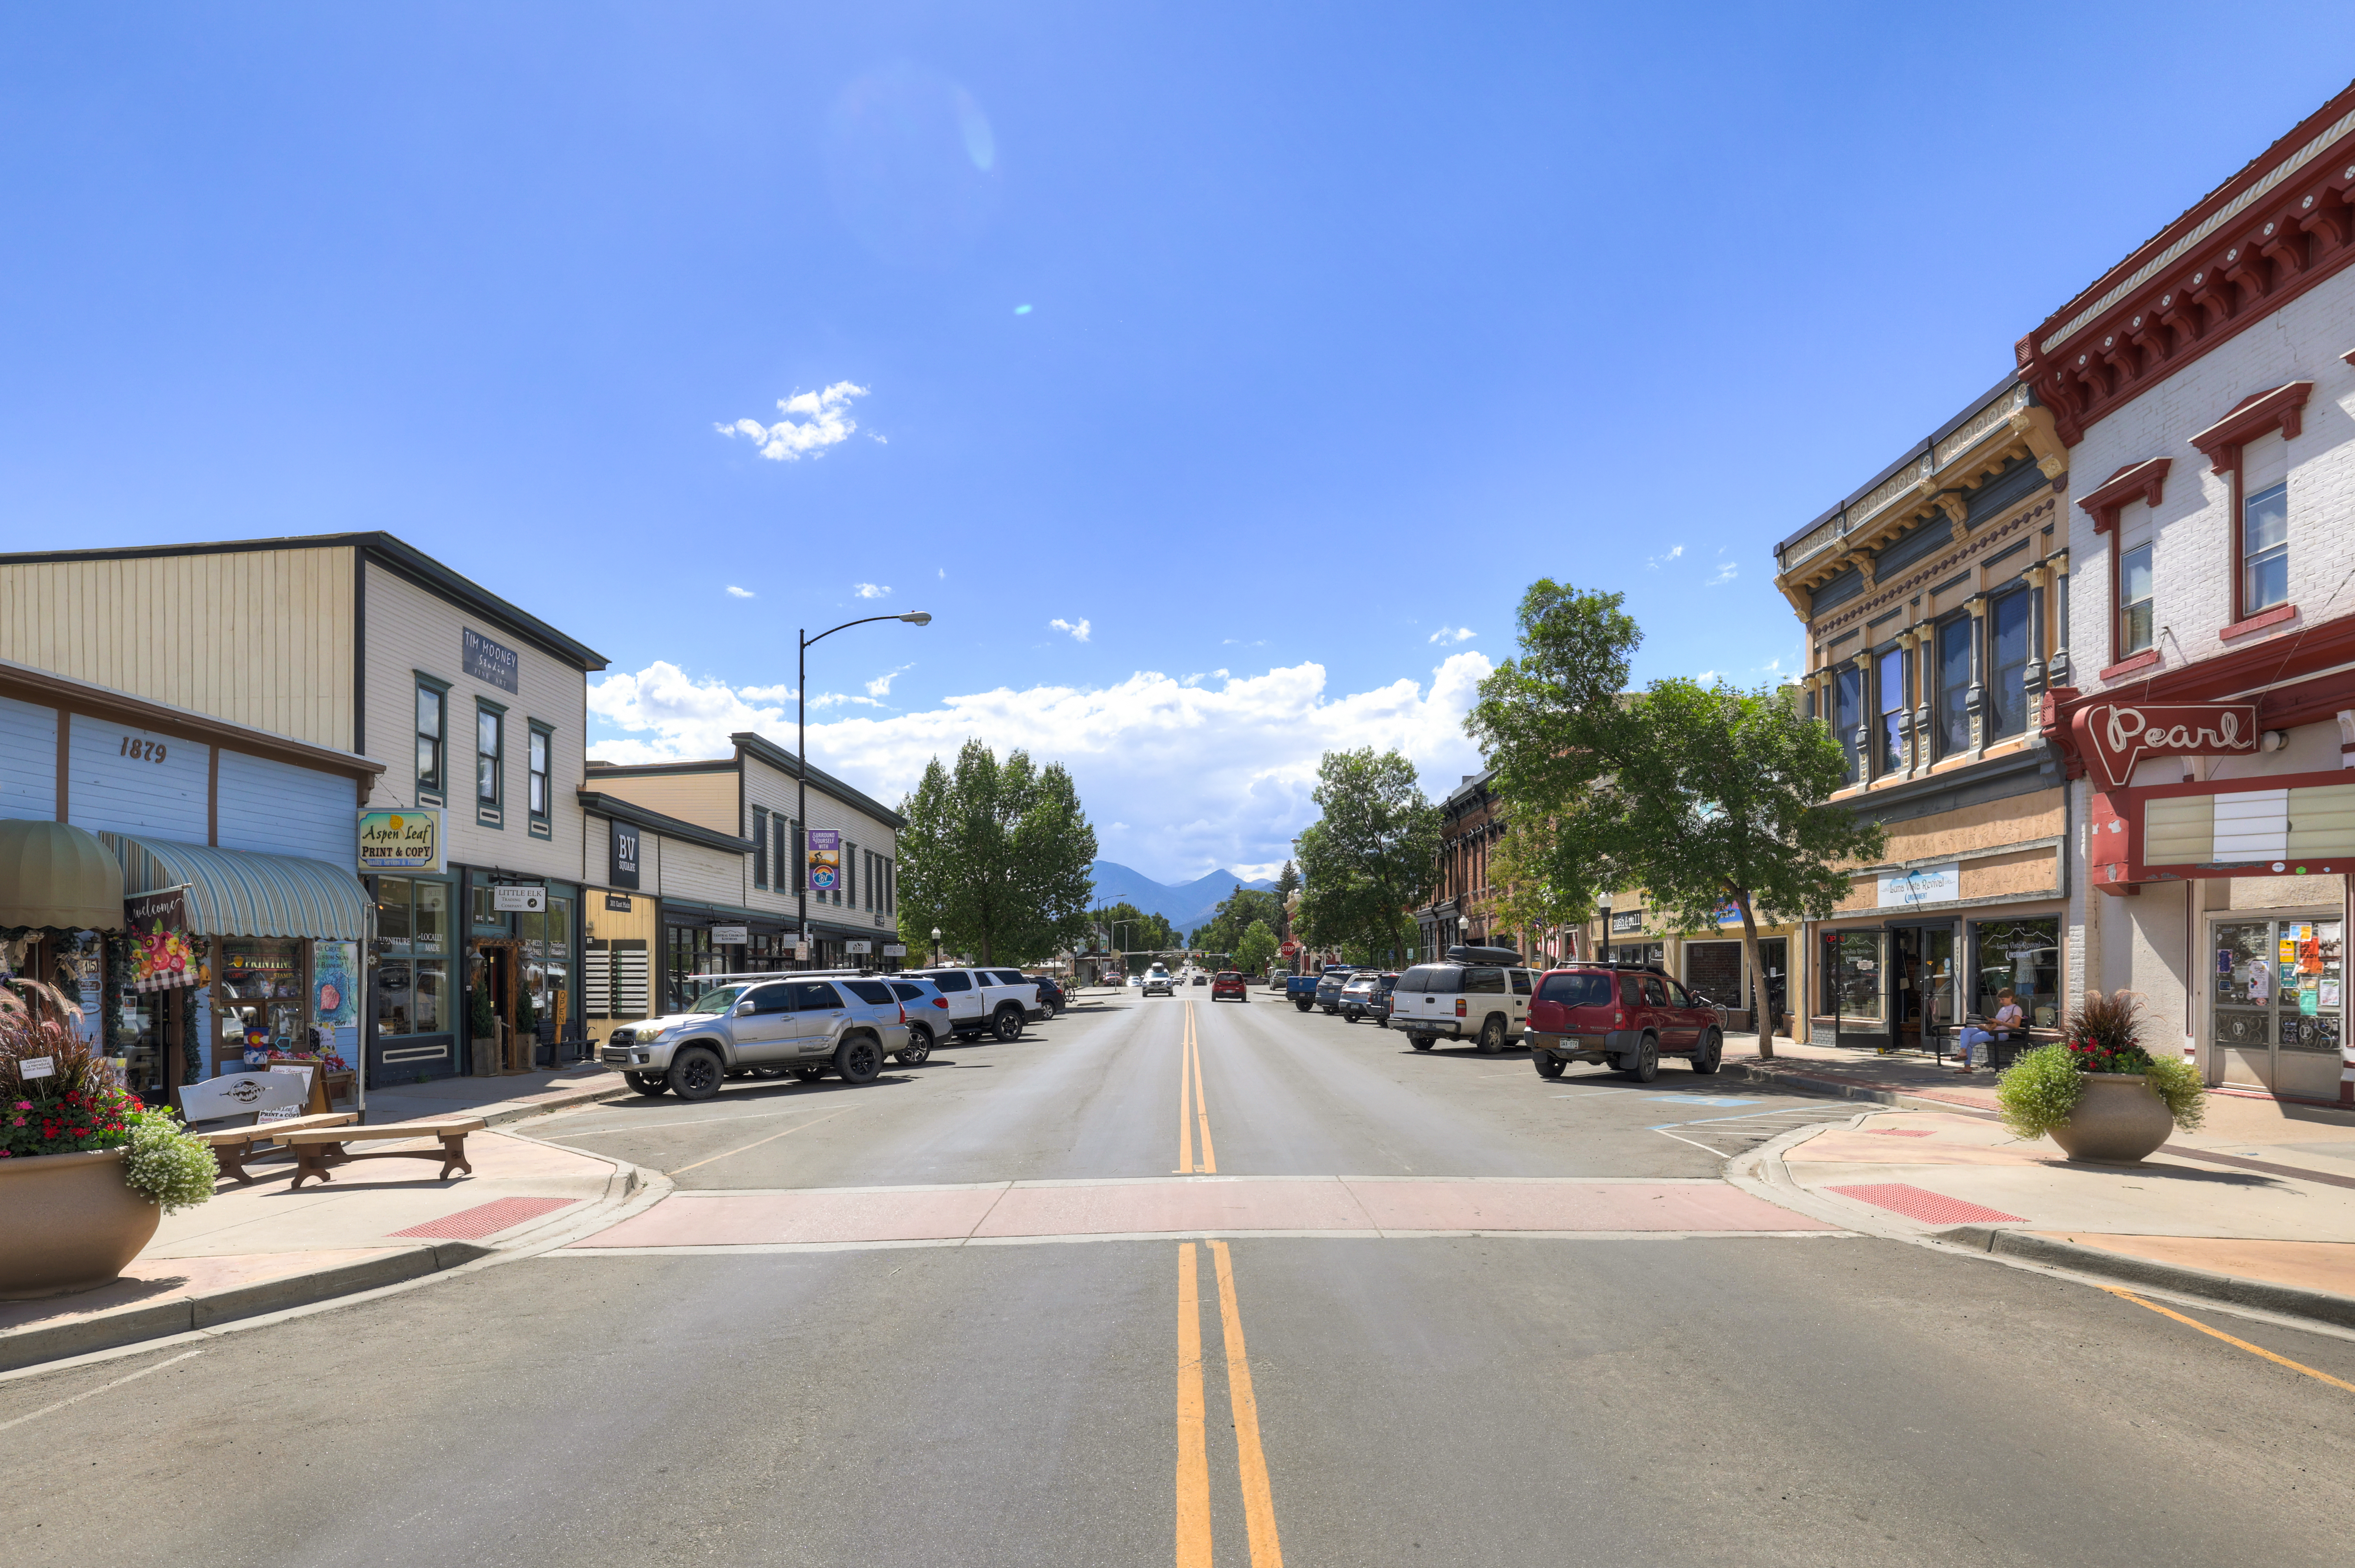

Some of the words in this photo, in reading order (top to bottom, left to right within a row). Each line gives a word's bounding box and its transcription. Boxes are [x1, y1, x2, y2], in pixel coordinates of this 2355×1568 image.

[466, 631, 479, 649] TIM
[482, 640, 516, 668] MOONEY
[479, 655, 504, 675] Studio
[475, 668, 489, 679] FINE
[495, 678, 506, 686] ART
[2107, 704, 2253, 753] Pearl
[120, 737, 167, 763] 1879
[362, 825, 399, 843] Aspen
[405, 825, 431, 843] Leaf
[362, 846, 393, 857] PRINT
[396, 847, 403, 857] &
[405, 846, 431, 857] COPY
[618, 834, 636, 861] BV
[619, 860, 636, 872] SQUARE
[819, 874, 830, 882] BV
[1890, 884, 1904, 893] Luna
[1906, 882, 1920, 891] Vista
[1922, 877, 1944, 890] Revival
[127, 898, 183, 922] welcome
[1614, 916, 1624, 930] push
[1625, 916, 1629, 927] &
[1629, 913, 1640, 929] pull
[421, 933, 443, 941] LOCALLY
[2023, 941, 2041, 949] Revival
[1654, 949, 1663, 958] Bar
[245, 956, 294, 969] PRINTING
